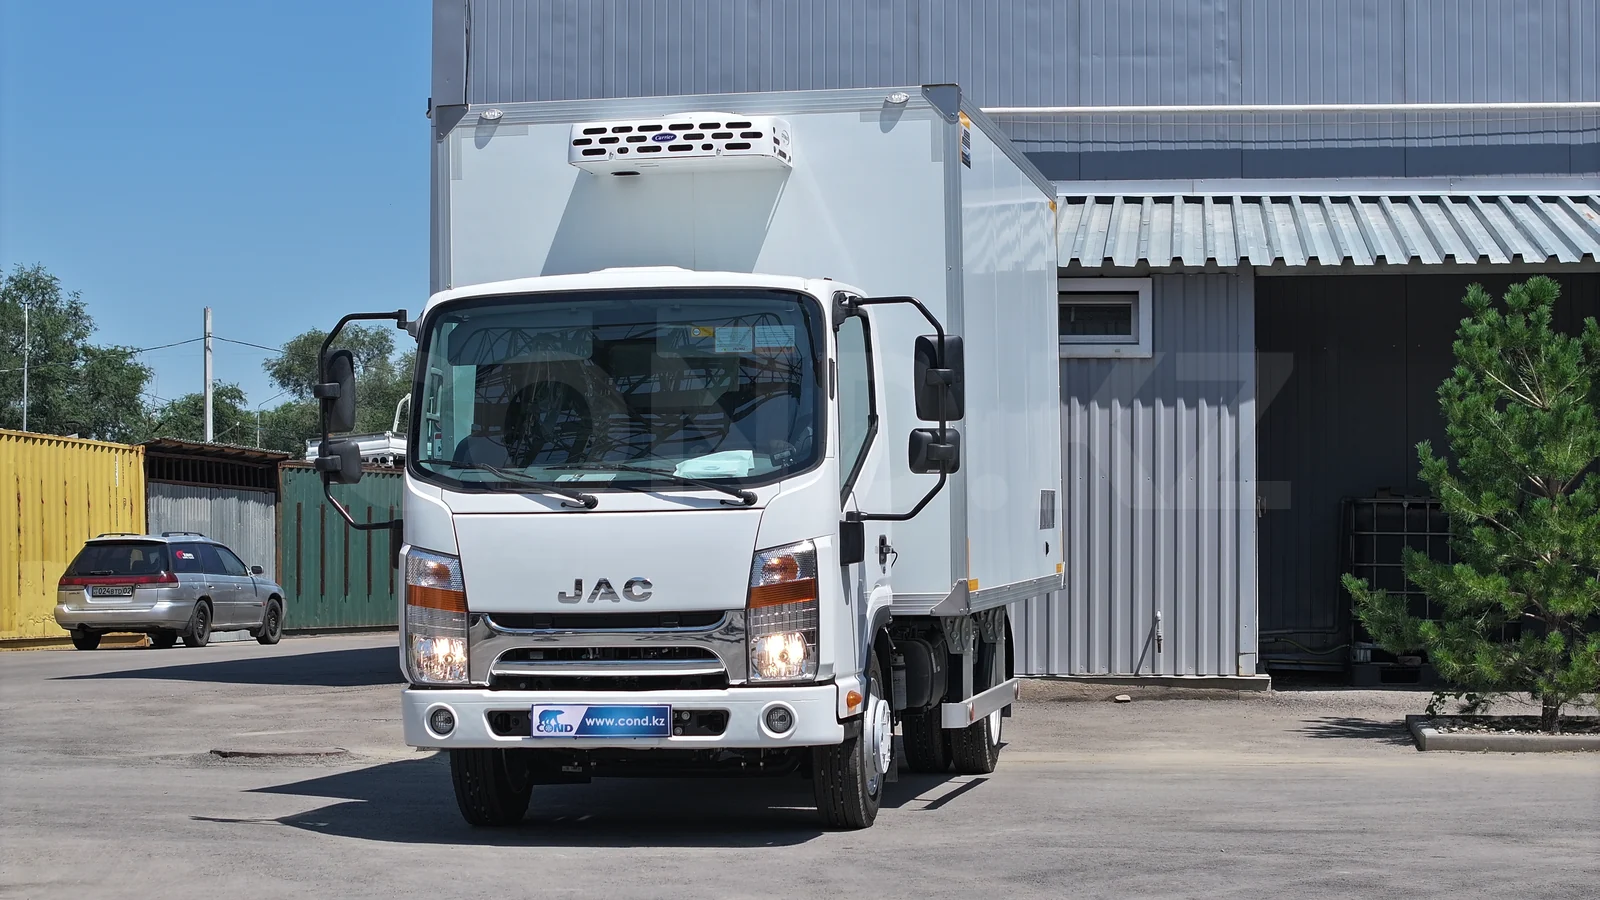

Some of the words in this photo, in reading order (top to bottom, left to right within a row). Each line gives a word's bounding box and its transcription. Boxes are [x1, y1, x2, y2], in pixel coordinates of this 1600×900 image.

[557, 576, 653, 604] JAC
[585, 715, 665, 727] www.cond.kz
[536, 723, 574, 733] COND
